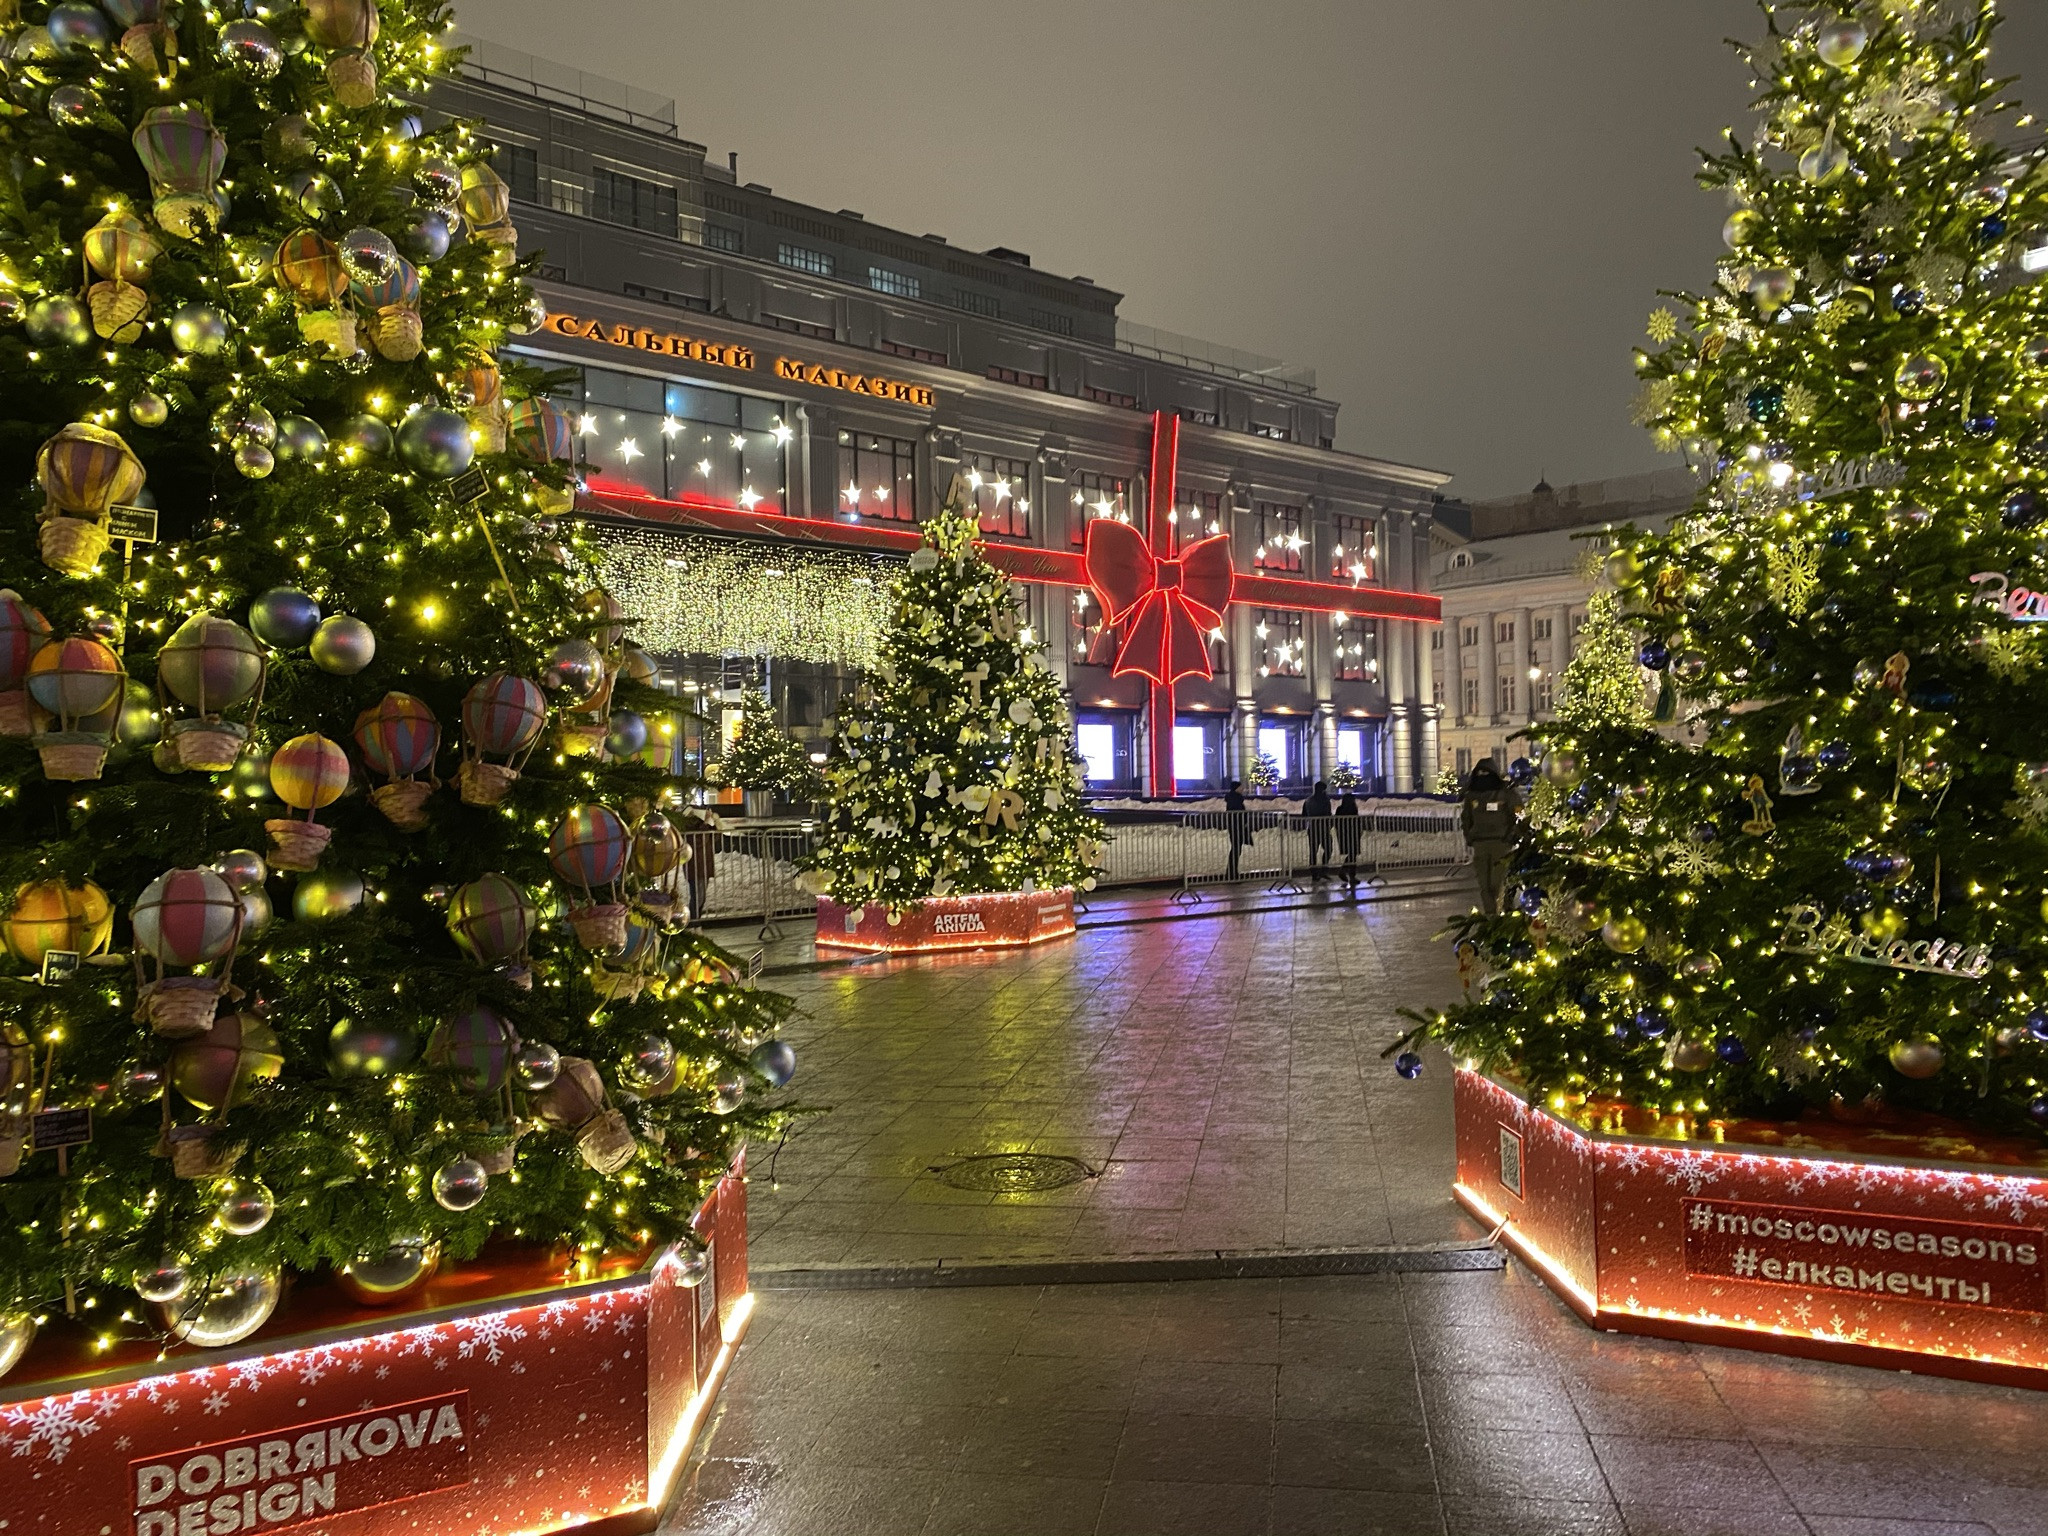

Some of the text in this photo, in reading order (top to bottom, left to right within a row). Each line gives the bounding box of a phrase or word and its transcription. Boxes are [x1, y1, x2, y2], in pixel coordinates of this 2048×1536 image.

[545, 314, 934, 406] САЛЬНЫЙ МАГАЗИН
[936, 921, 985, 934] KRIVDA
[1689, 1203, 2039, 1267] #moscowseasons
[1731, 1246, 1992, 1305] #елкамечты
[137, 1471, 337, 1536] DESIGN
